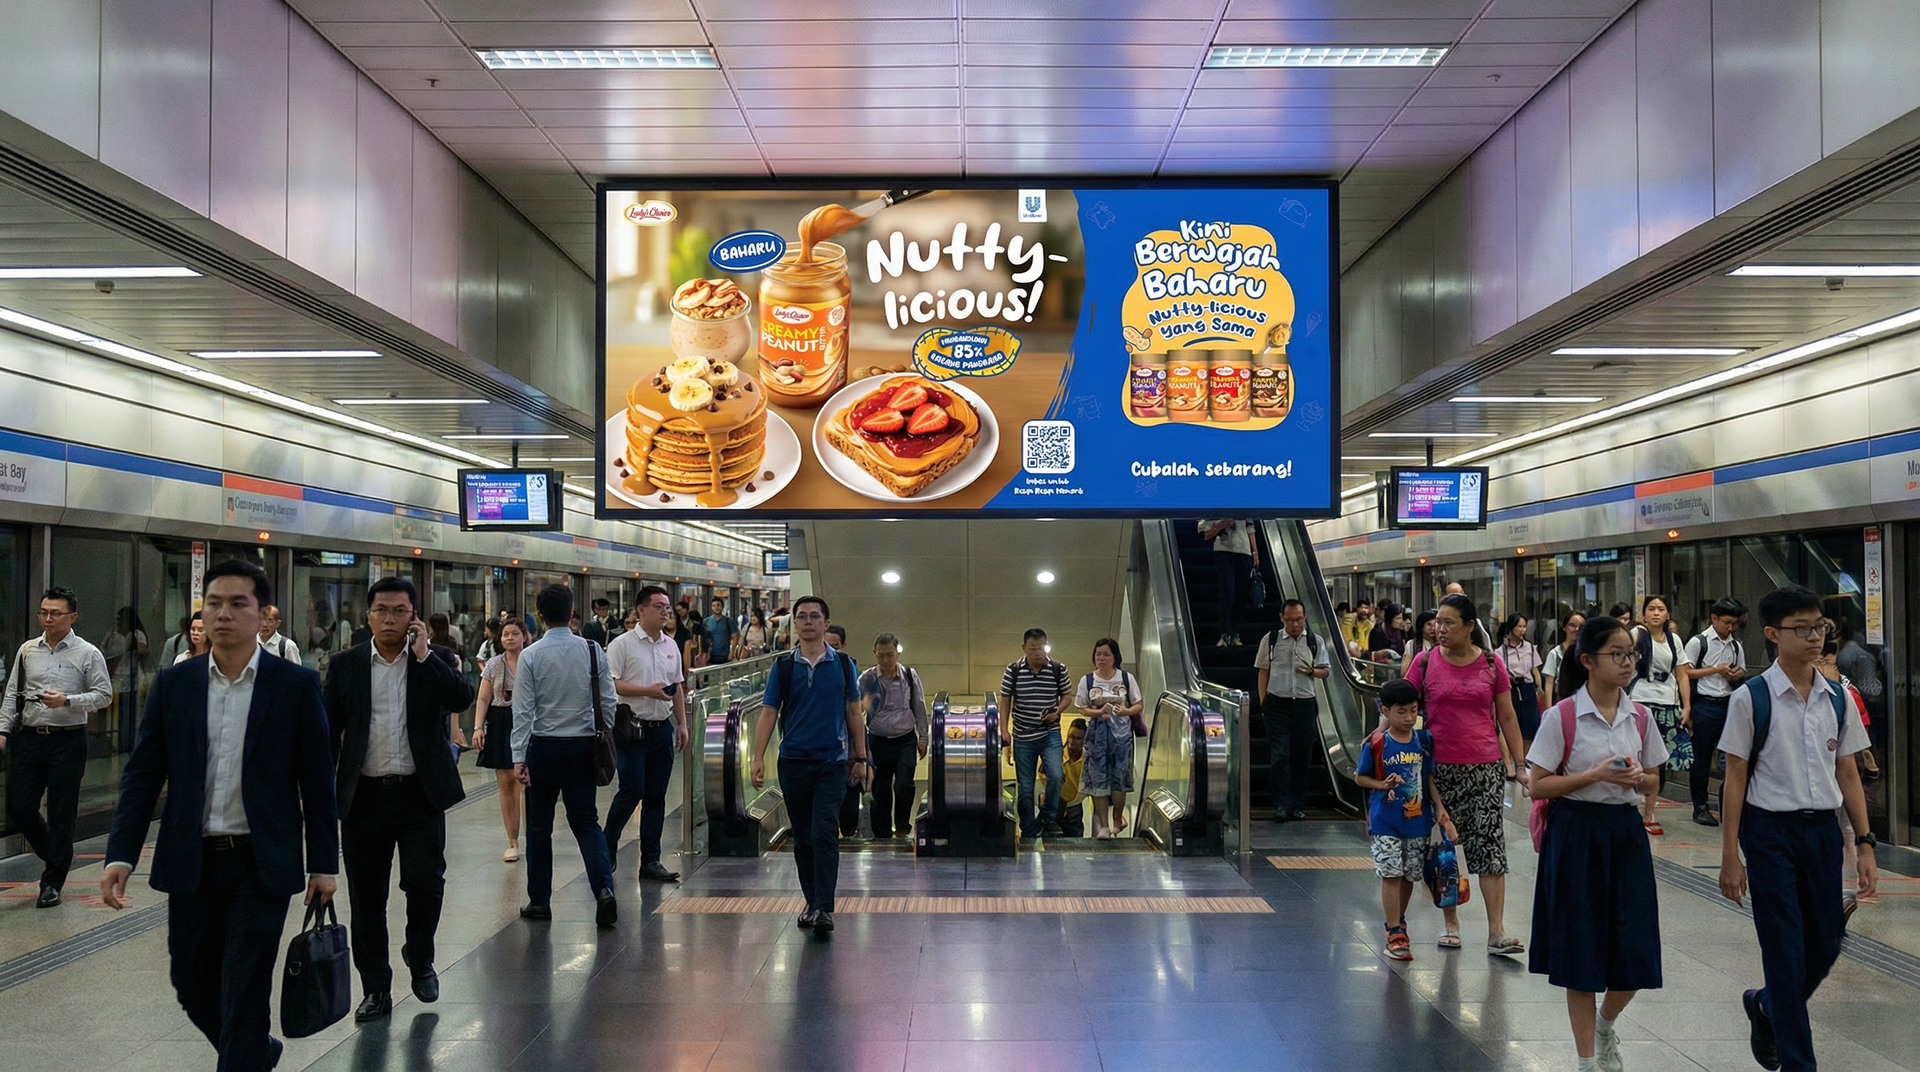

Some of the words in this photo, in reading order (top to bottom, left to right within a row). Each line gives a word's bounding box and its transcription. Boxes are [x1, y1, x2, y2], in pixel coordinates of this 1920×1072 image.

[1179, 220, 1231, 242] Kini
[719, 240, 776, 261] BAHARU
[866, 222, 1069, 284] Nutty-
[1135, 238, 1281, 272] Berwajah
[1143, 267, 1266, 300] Baharu
[884, 280, 1045, 330] licious!
[1148, 300, 1267, 324] Nutty-licious
[762, 320, 819, 340] CREAMY
[1160, 320, 1206, 338] yang
[1211, 317, 1256, 338] Sama
[762, 330, 820, 353] PEANUT
[953, 344, 983, 359] 85%
[1131, 460, 1199, 478] Cubalah
[1205, 460, 1292, 479] sebarang!
